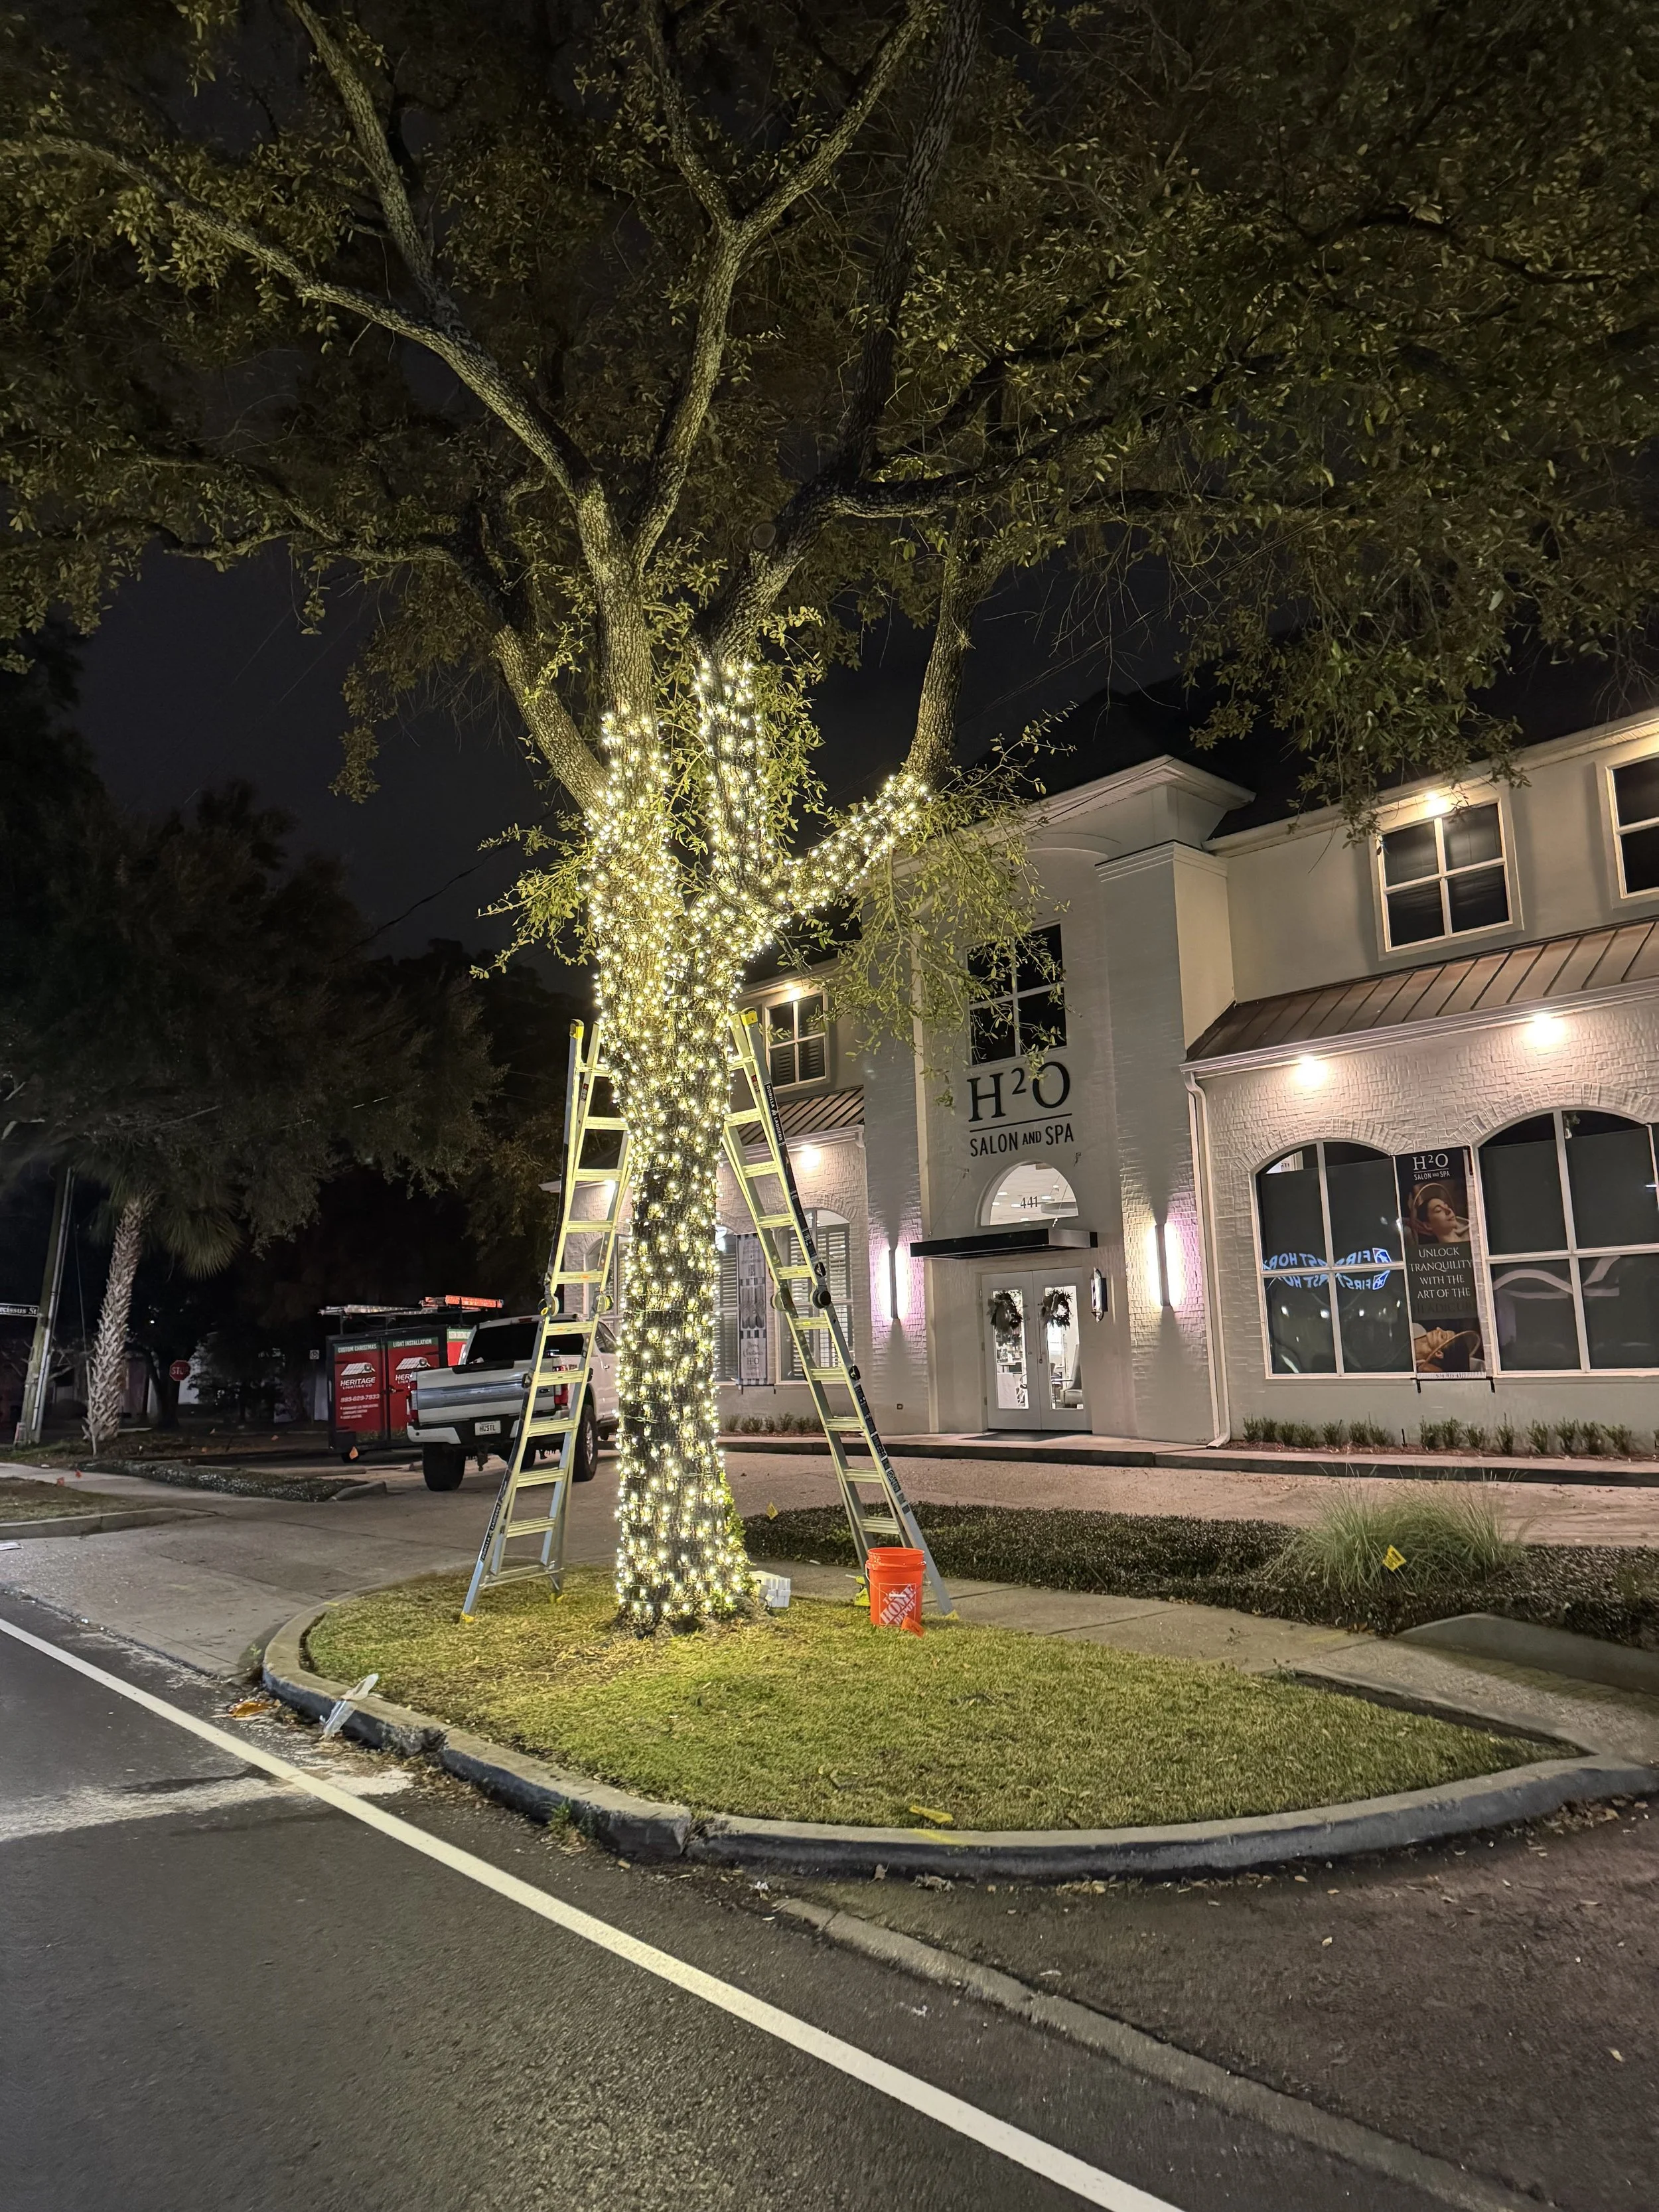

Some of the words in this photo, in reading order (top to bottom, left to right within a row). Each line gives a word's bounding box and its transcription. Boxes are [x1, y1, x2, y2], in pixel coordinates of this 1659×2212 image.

[766, 1085, 775, 1108] GORILLA
[774, 1116, 783, 1142] LADDERS
[970, 1132, 1018, 1157] SALON
[1022, 1130, 1042, 1146] AND
[1045, 1123, 1074, 1146] SPA
[1413, 1172, 1432, 1181] SALON
[1020, 1195, 1038, 1209] 441
[1418, 1246, 1461, 1258] UNLOCK
[1409, 1259, 1473, 1272] TRANQUILITY
[1419, 1275, 1445, 1286] WITH
[1446, 1274, 1465, 1285] THE
[1417, 1289, 1435, 1299] ART
[1436, 1288, 1449, 1298] OF
[1451, 1287, 1471, 1298] THE
[354, 1343, 377, 1352] CHRISTMAS
[405, 1338, 433, 1347] INSTALLATION
[340, 1376, 376, 1386] HERITAGE
[881, 1584, 916, 1625] HOME
